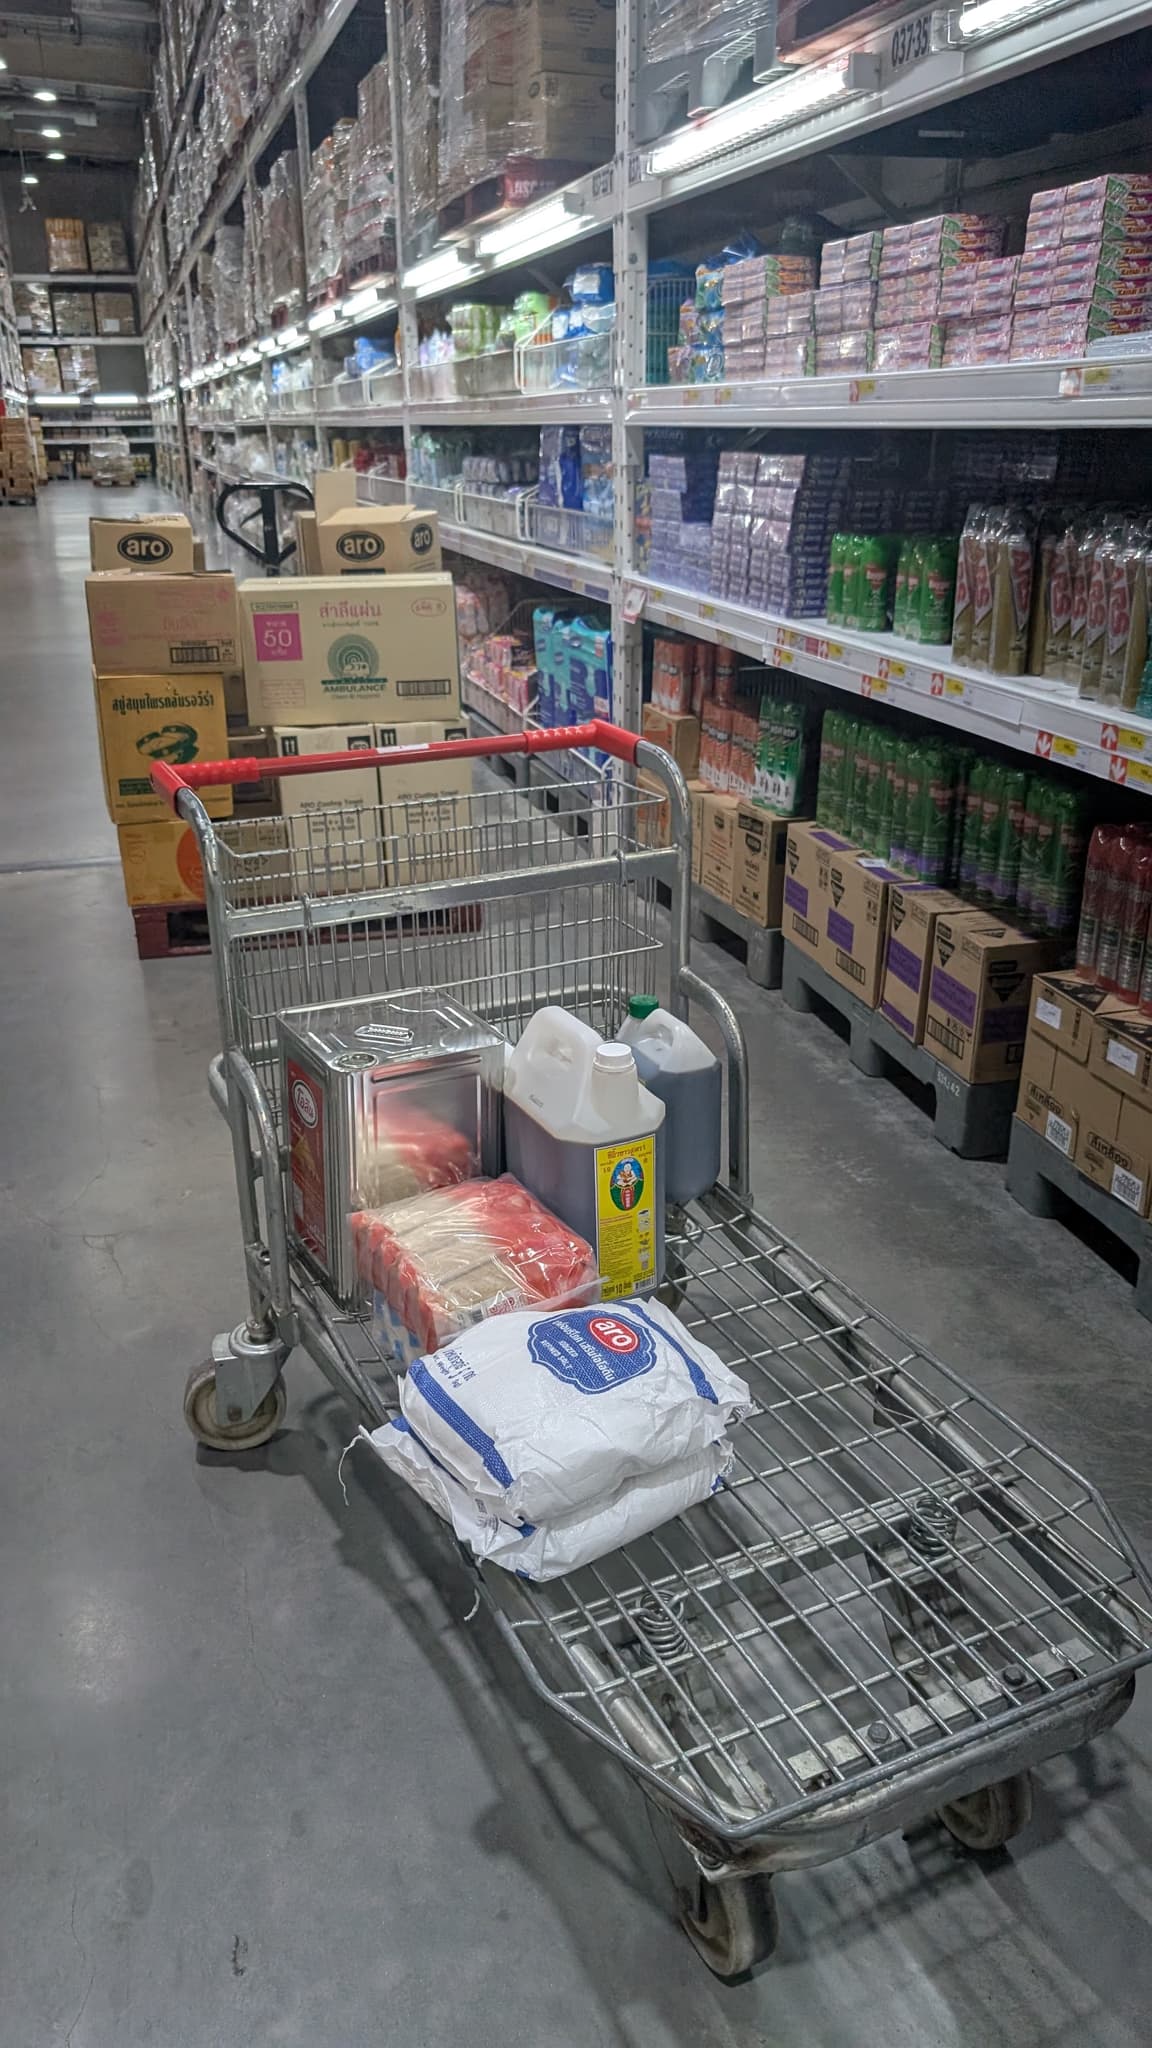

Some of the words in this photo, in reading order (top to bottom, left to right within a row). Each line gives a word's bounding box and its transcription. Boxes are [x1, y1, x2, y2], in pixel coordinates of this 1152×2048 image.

[343, 538, 378, 555] aro
[413, 528, 430, 548] aro
[126, 540, 165, 557] aro
[263, 629, 292, 648] 50
[323, 683, 387, 694] AMBULANCE
[594, 1320, 633, 1347] aro
[557, 1355, 573, 1370] SALT
